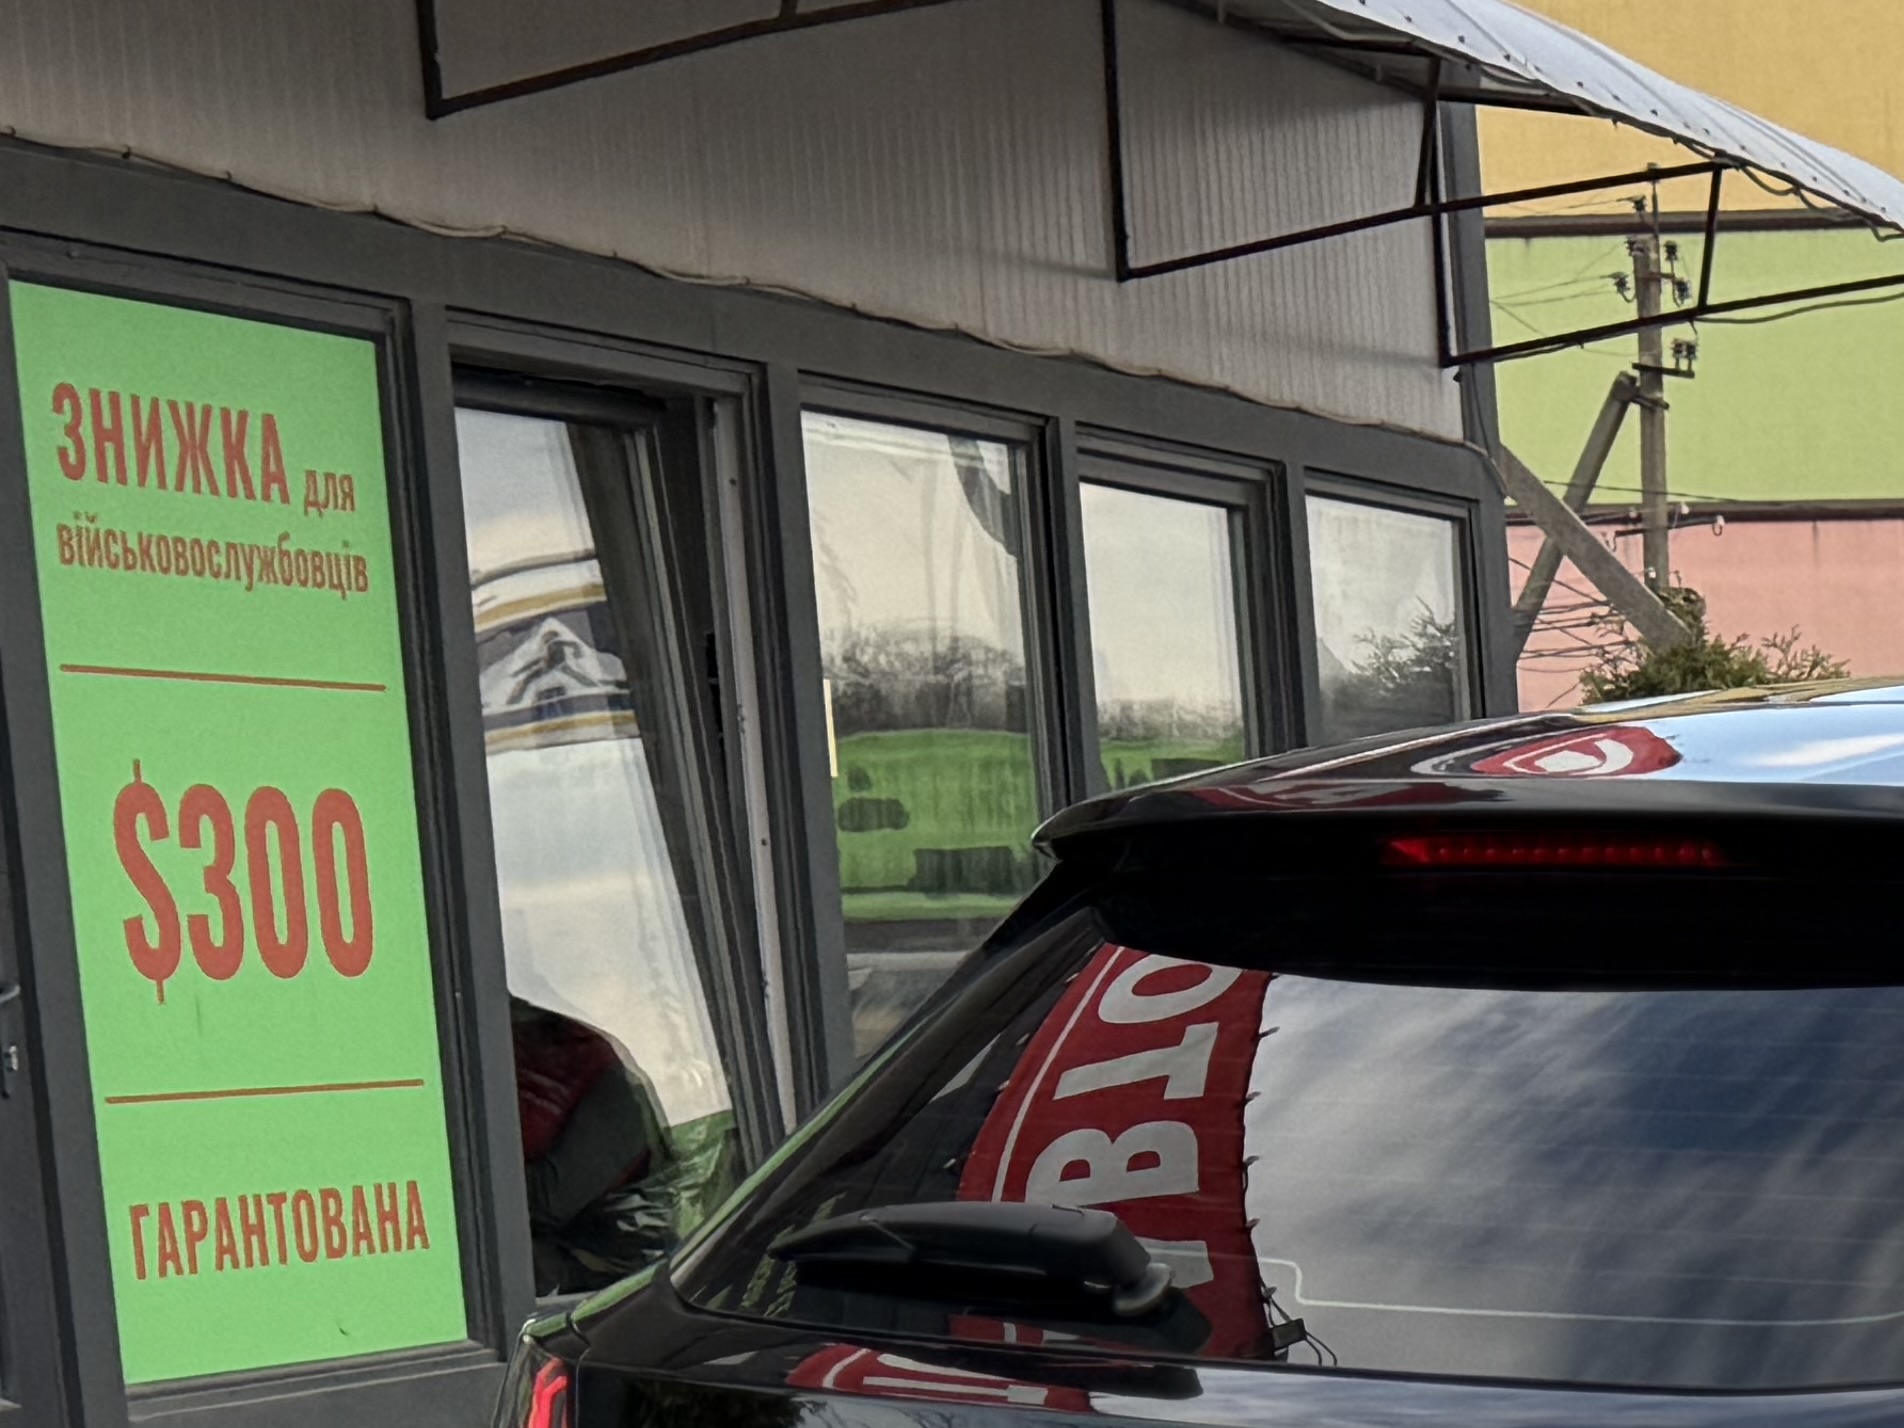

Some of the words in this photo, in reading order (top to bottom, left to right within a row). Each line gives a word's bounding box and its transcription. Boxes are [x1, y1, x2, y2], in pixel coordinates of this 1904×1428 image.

[52, 382, 291, 505] ЗНИЖКА
[303, 470, 356, 518] для
[56, 511, 369, 600] військовослужбовців
[113, 761, 375, 1003] $300
[129, 1180, 431, 1281] ГАРАНТОВАНА
